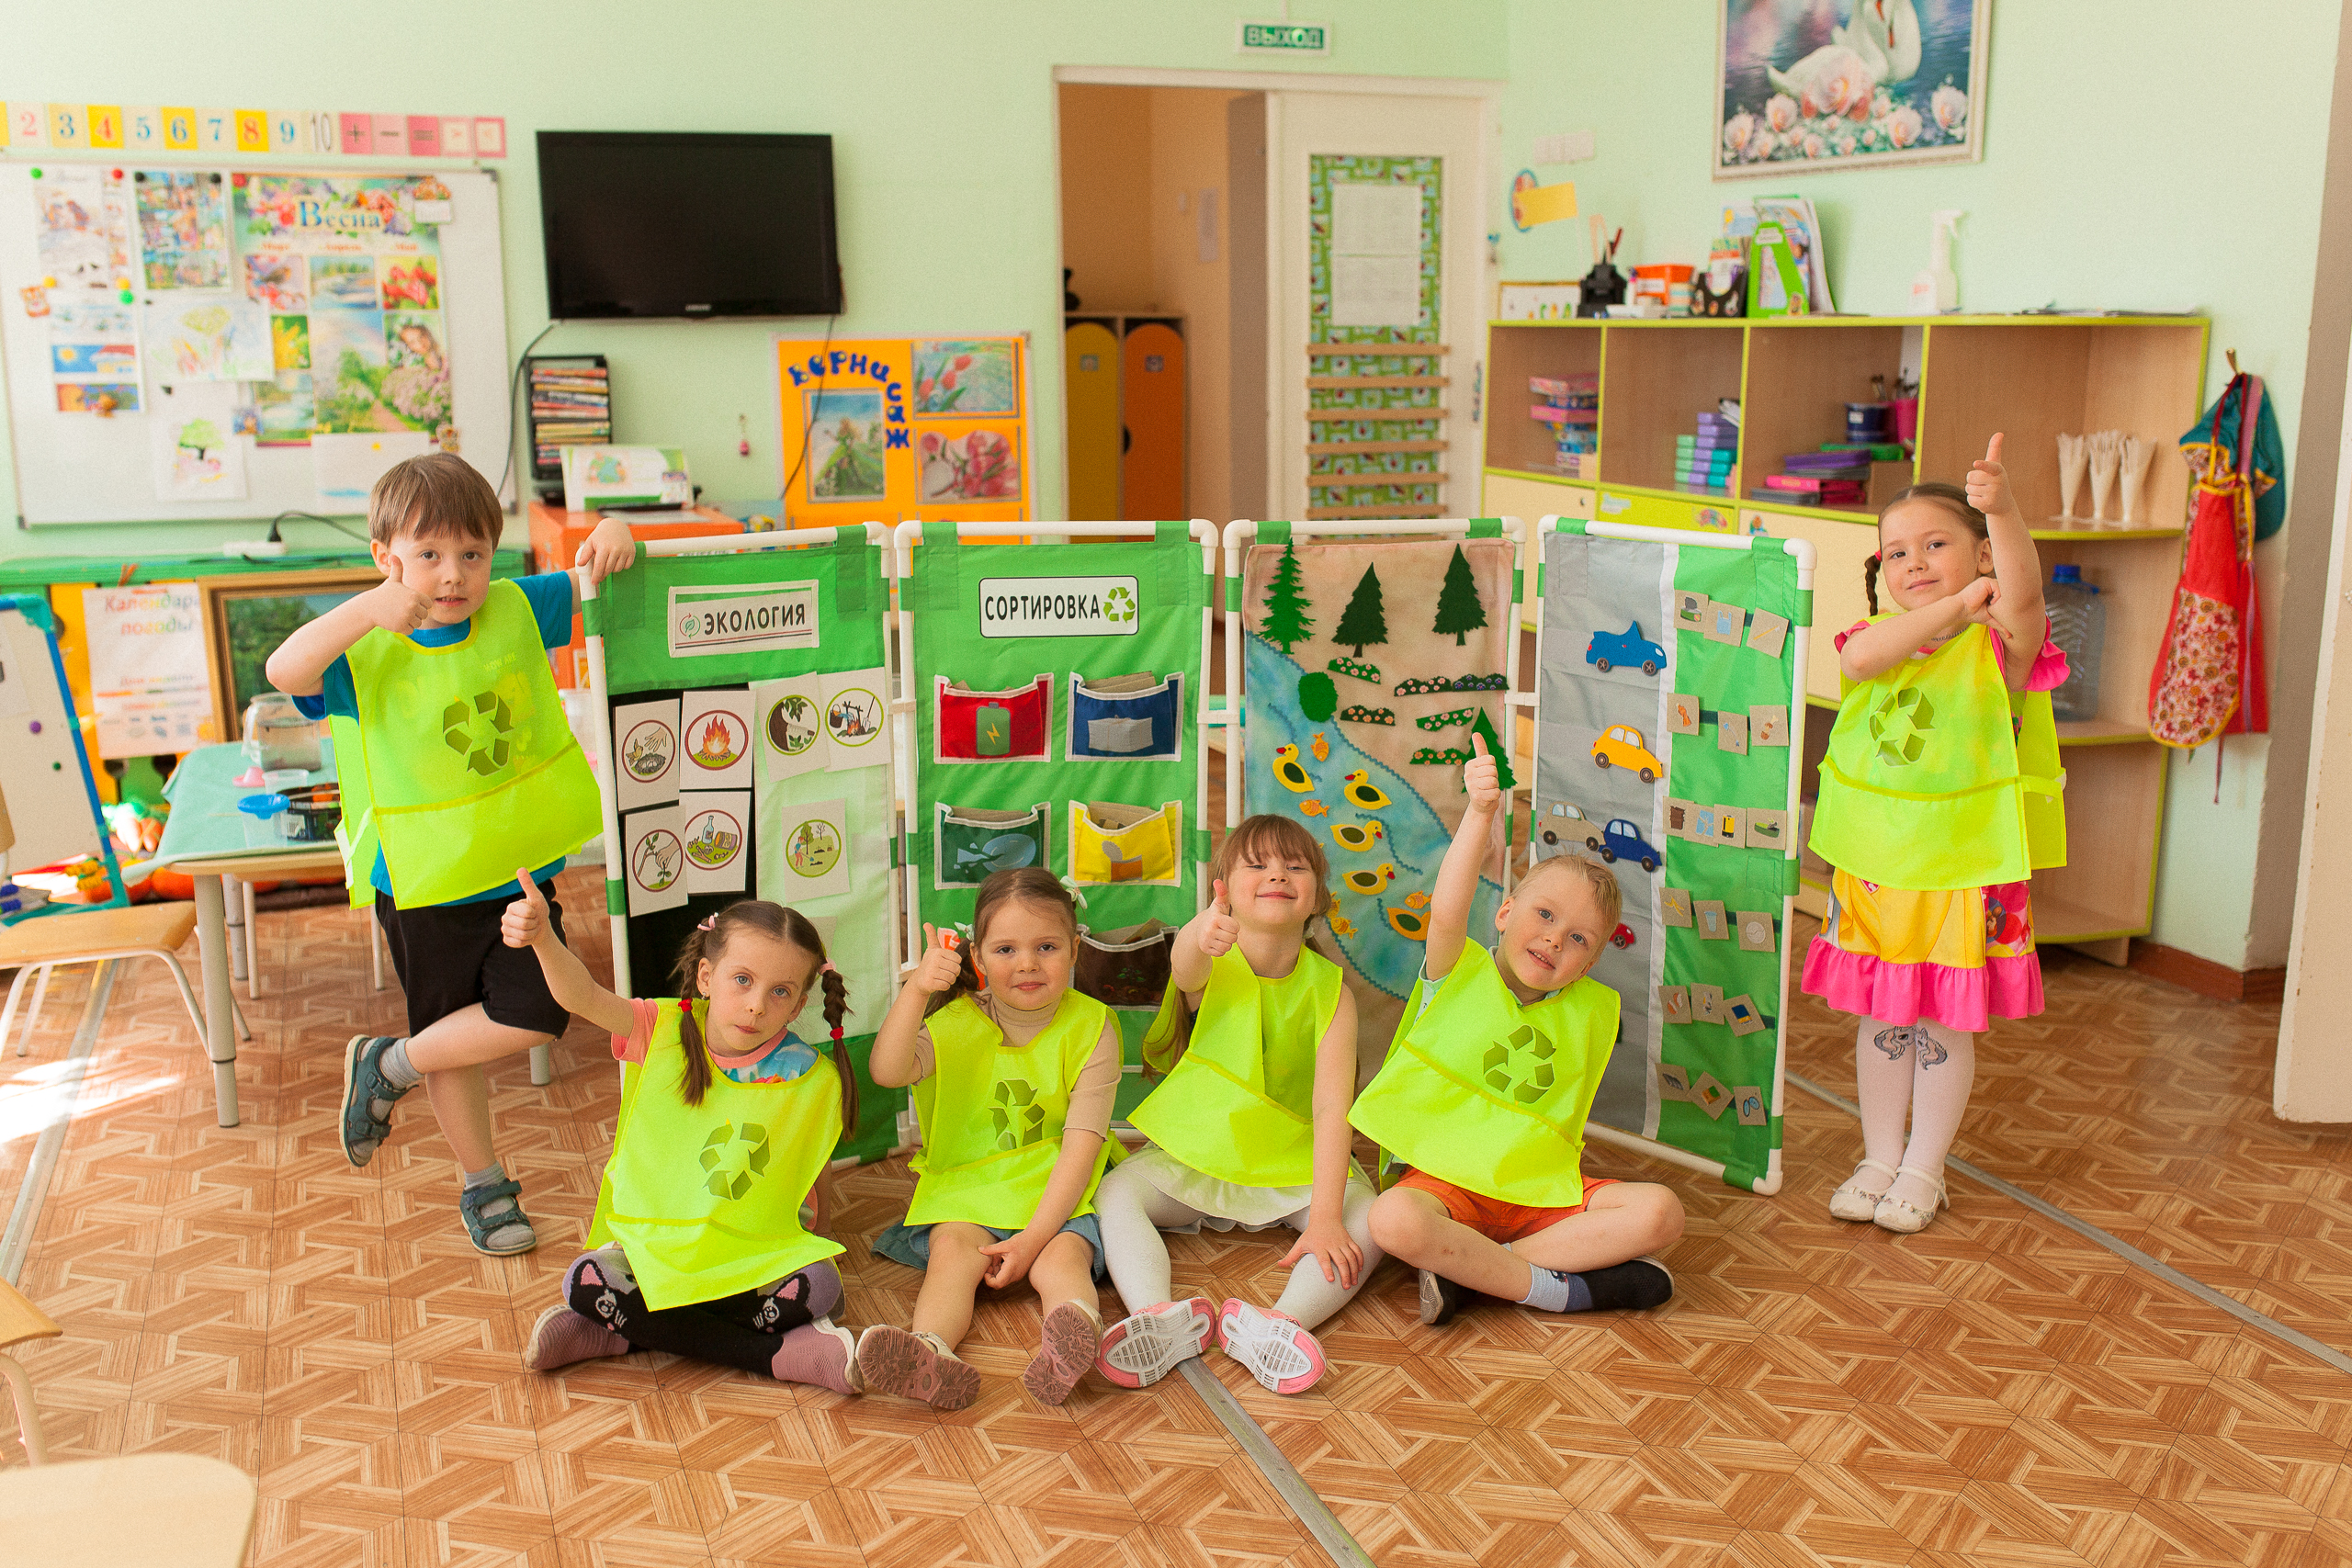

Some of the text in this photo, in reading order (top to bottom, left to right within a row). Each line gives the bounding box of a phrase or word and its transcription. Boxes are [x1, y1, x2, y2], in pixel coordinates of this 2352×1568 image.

[1247, 27, 1321, 47] ВЫХОД
[20, 111, 38, 136] 2
[59, 113, 75, 138] 3
[95, 114, 115, 141] 4
[136, 116, 151, 140] 5
[172, 117, 188, 143] 6
[208, 118, 221, 141] 7
[243, 117, 260, 144] 8
[279, 119, 294, 144] 9
[310, 112, 332, 152] 10
[299, 200, 381, 228] Весна
[704, 603, 806, 636] ЭКОЛОГИЯ
[985, 593, 1101, 621] СОРТИРОВКА
